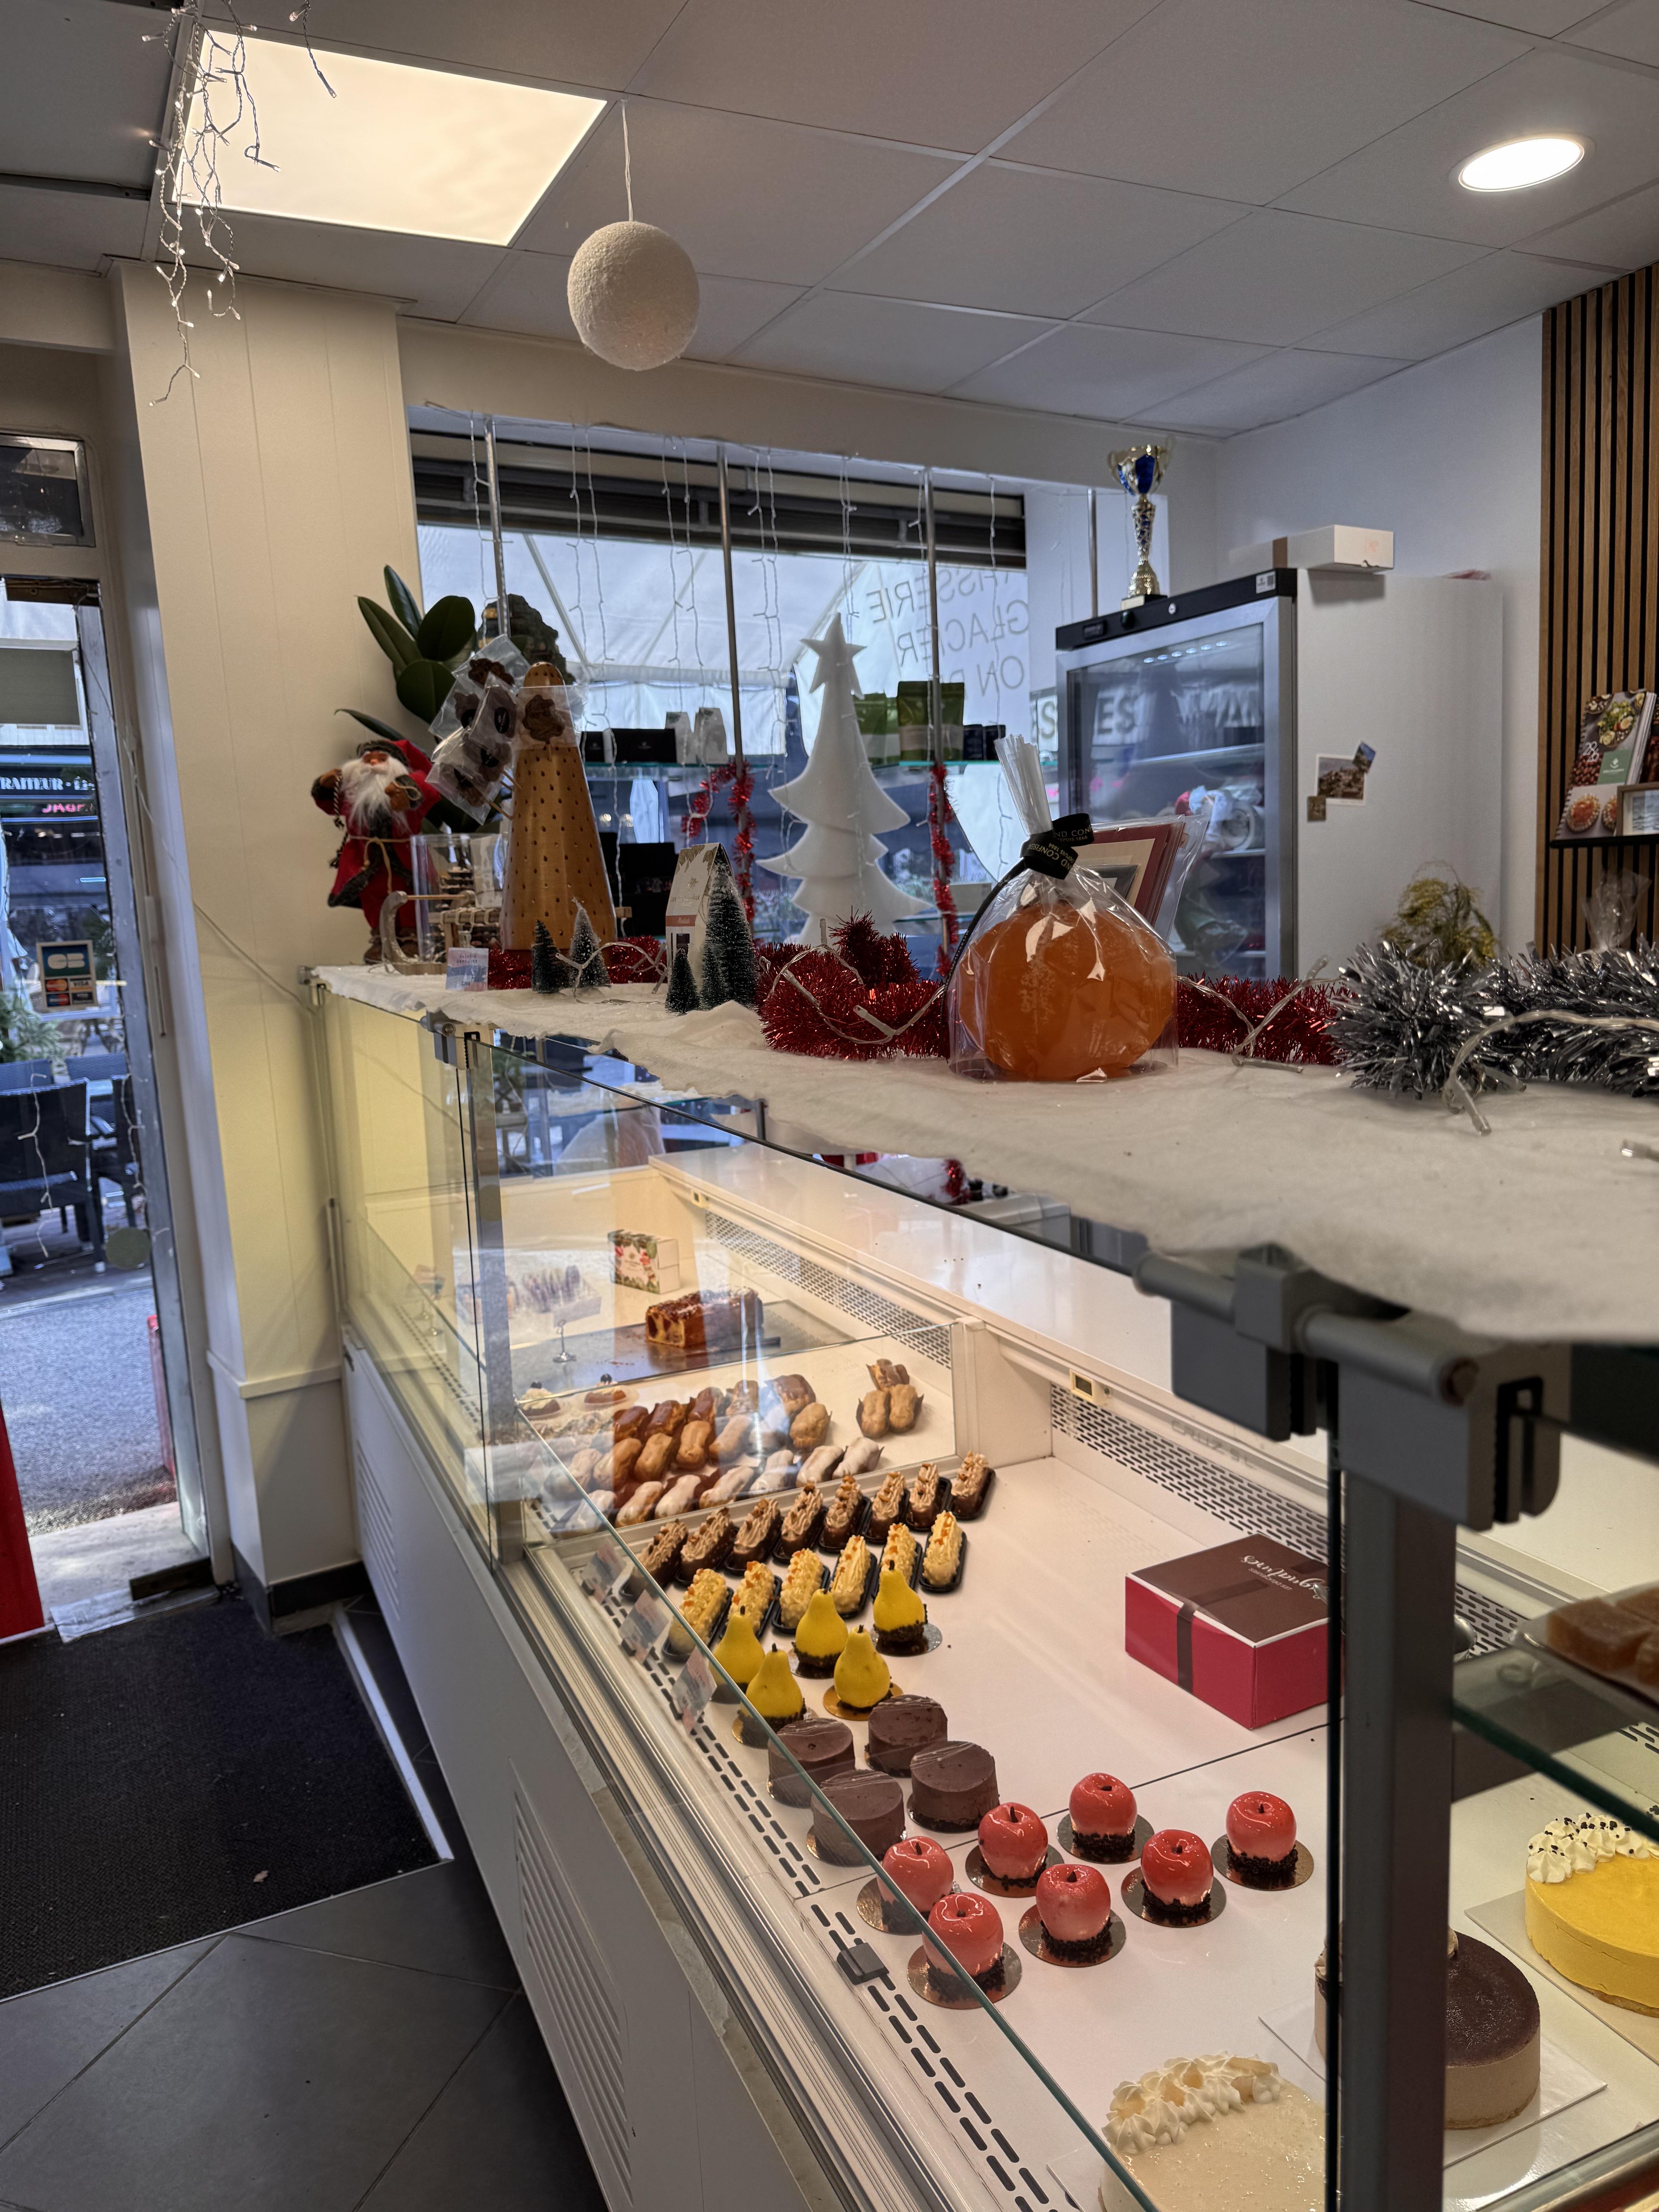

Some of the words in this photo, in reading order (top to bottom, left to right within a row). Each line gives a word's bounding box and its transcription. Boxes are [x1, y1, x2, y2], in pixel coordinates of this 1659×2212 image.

[1049, 843, 1059, 851] 1866
[1060, 850, 1074, 863] DEPUIS
[1061, 859, 1072, 870] ND
[1240, 1555, 1330, 1599] gnatures
